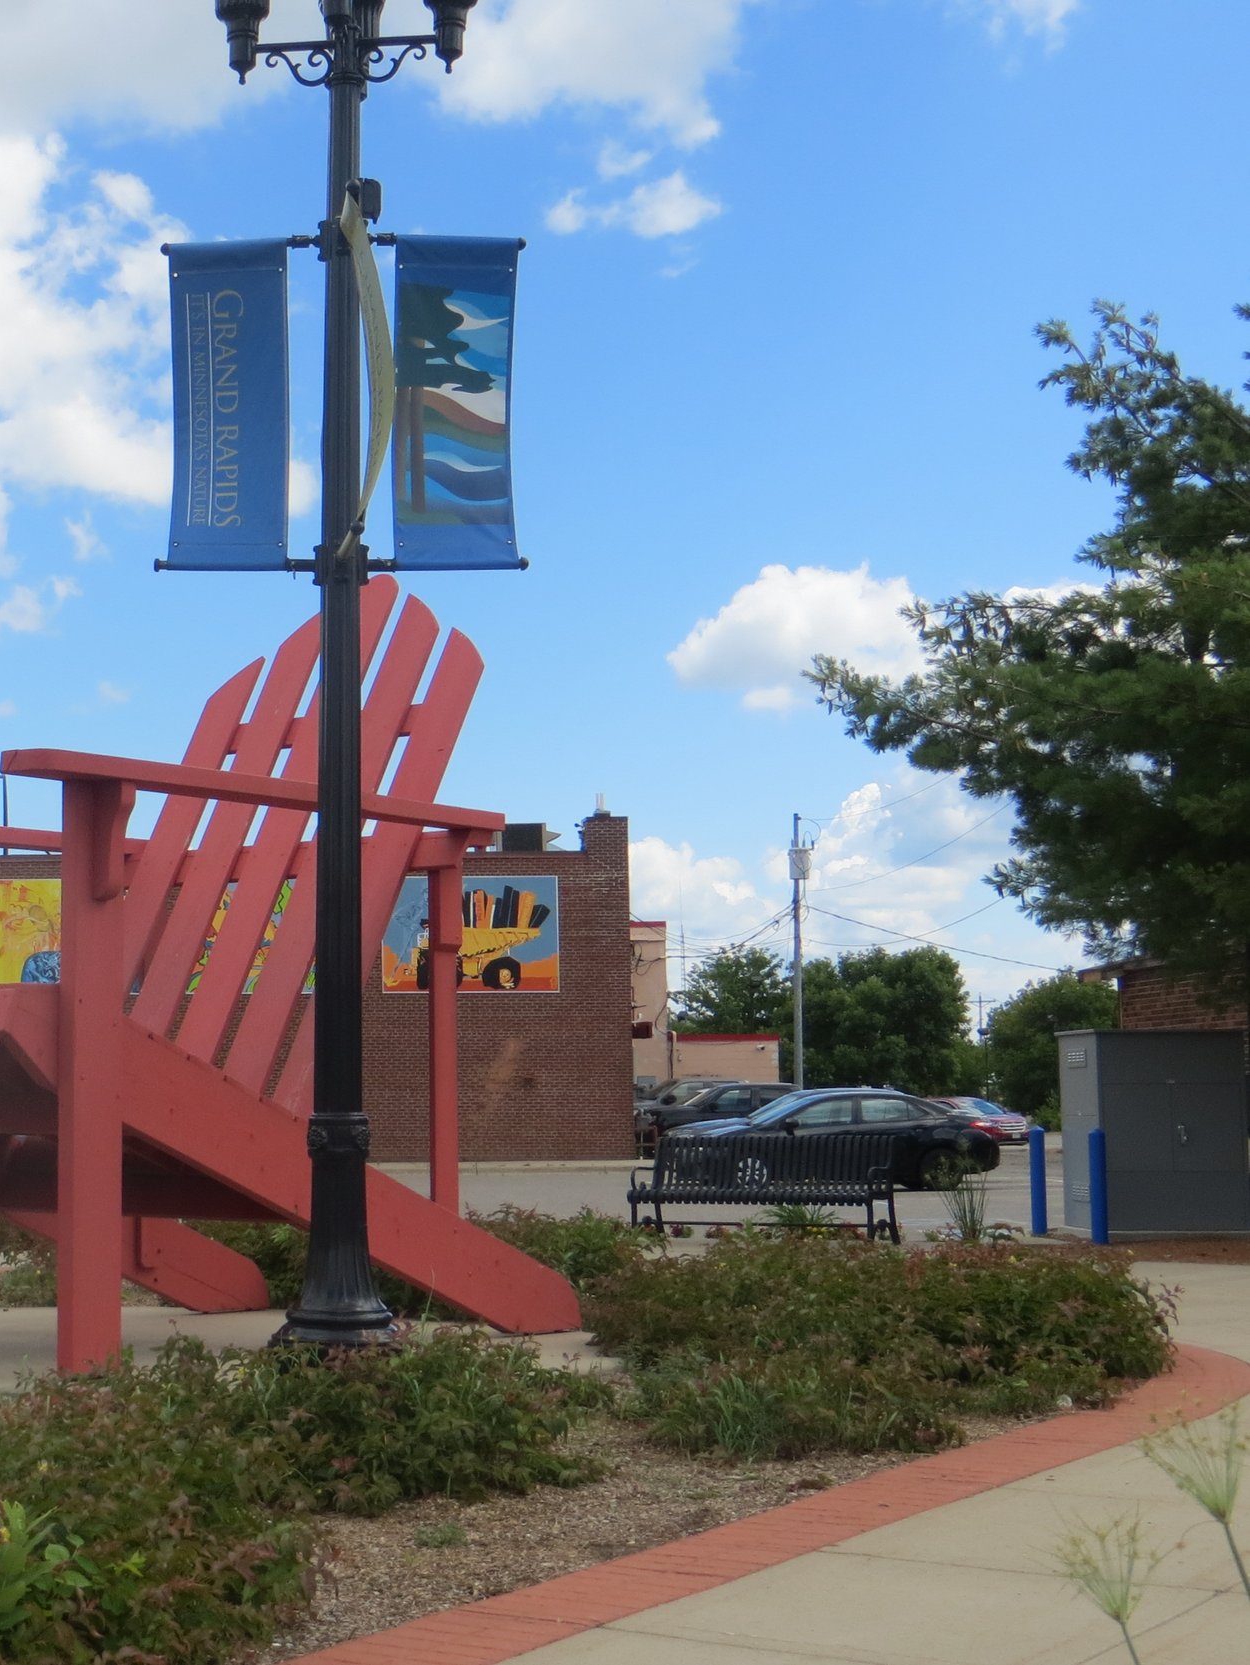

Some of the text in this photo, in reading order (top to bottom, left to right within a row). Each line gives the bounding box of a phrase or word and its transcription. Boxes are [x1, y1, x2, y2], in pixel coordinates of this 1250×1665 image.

[192, 327, 206, 345] IN
[213, 290, 244, 527] GRAND RAPIDS
[192, 467, 207, 525] NATURE
